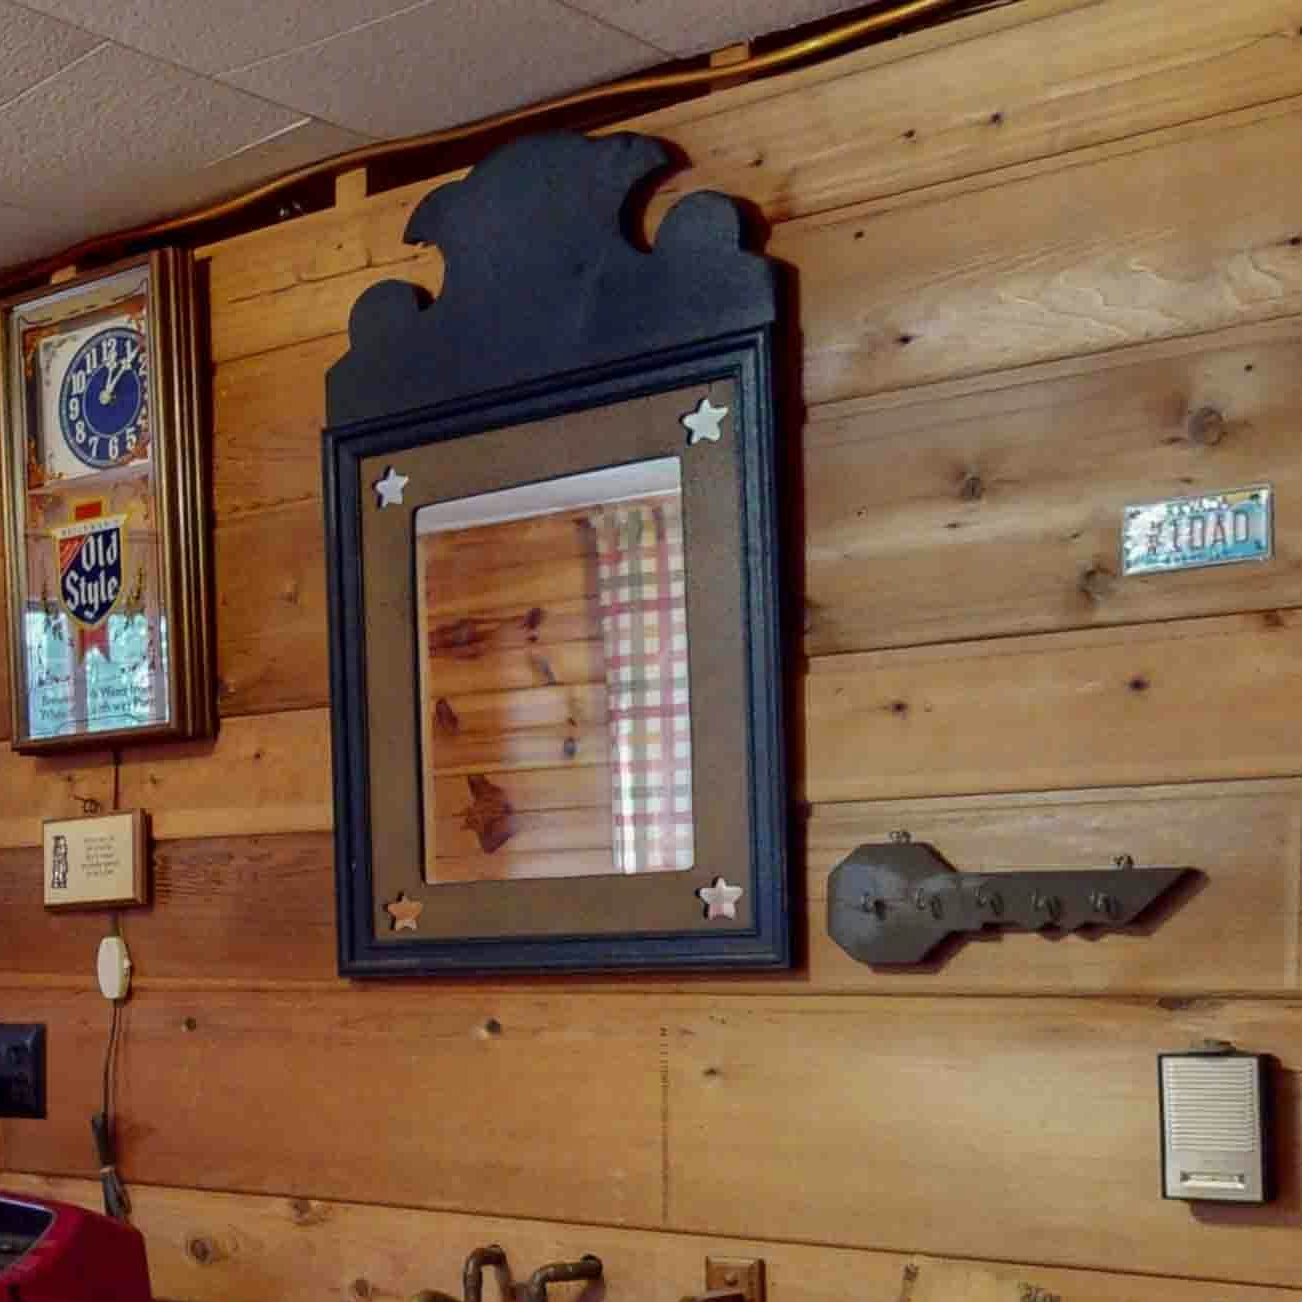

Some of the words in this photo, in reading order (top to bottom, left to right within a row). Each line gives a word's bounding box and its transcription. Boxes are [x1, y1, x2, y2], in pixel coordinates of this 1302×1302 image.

[85, 349, 98, 373] 11
[71, 372, 86, 395] 10
[68, 397, 80, 421] 9
[75, 420, 86, 444] 8
[125, 425, 137, 450] 5
[88, 435, 100, 458] 7
[108, 436, 119, 460] 6
[81, 530, 118, 572] Old
[65, 571, 119, 614] Style
